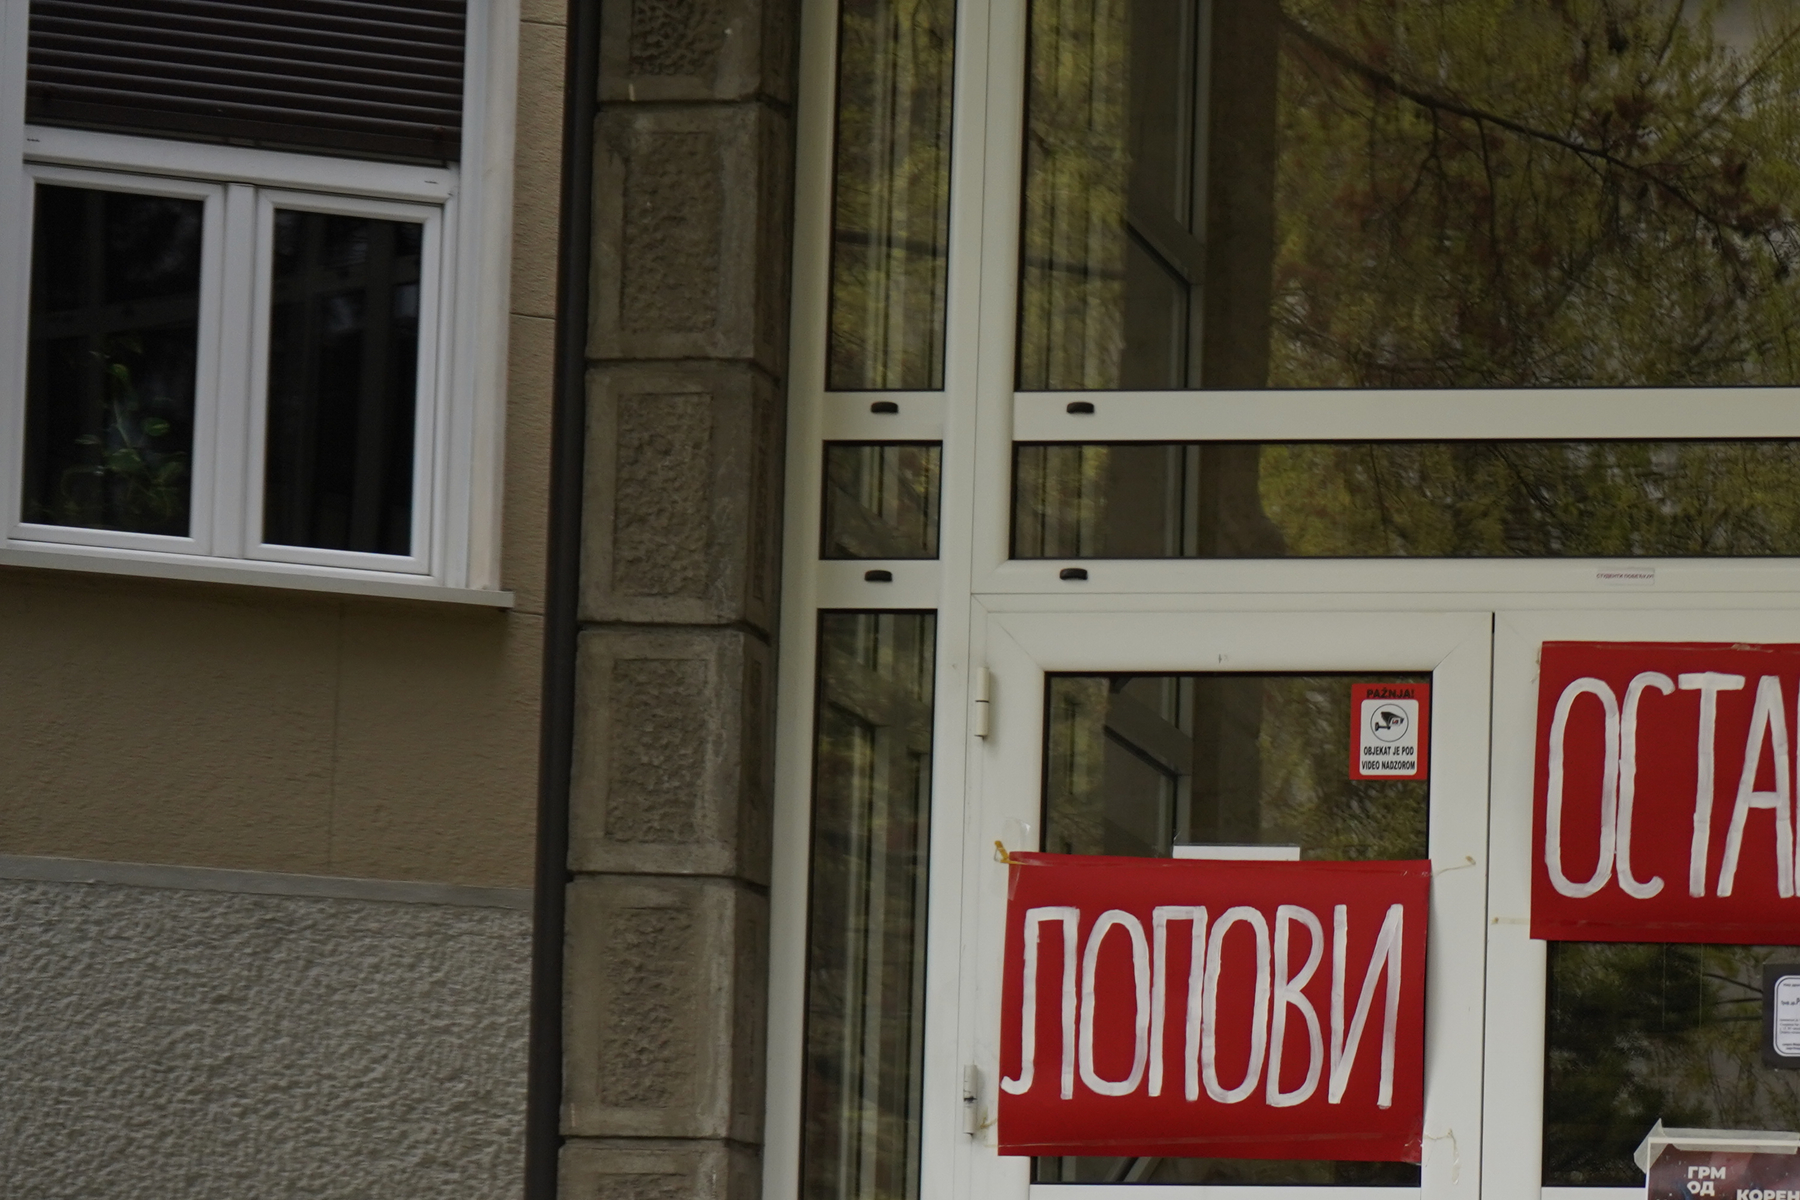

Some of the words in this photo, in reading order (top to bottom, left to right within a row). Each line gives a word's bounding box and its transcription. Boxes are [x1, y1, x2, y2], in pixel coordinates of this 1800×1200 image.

[1366, 687, 1415, 698] PAŽNJA!
[1363, 746, 1391, 756] OBJEKAT
[1392, 746, 1400, 756] JE
[1401, 746, 1415, 756] POD
[1362, 760, 1380, 770] VIDEO
[1381, 761, 1416, 770] NADZOROM
[1000, 904, 1403, 1109] ЛОПОВИ
[1687, 1166, 1726, 1180] ГРМ
[1687, 1181, 1715, 1196] ОД
